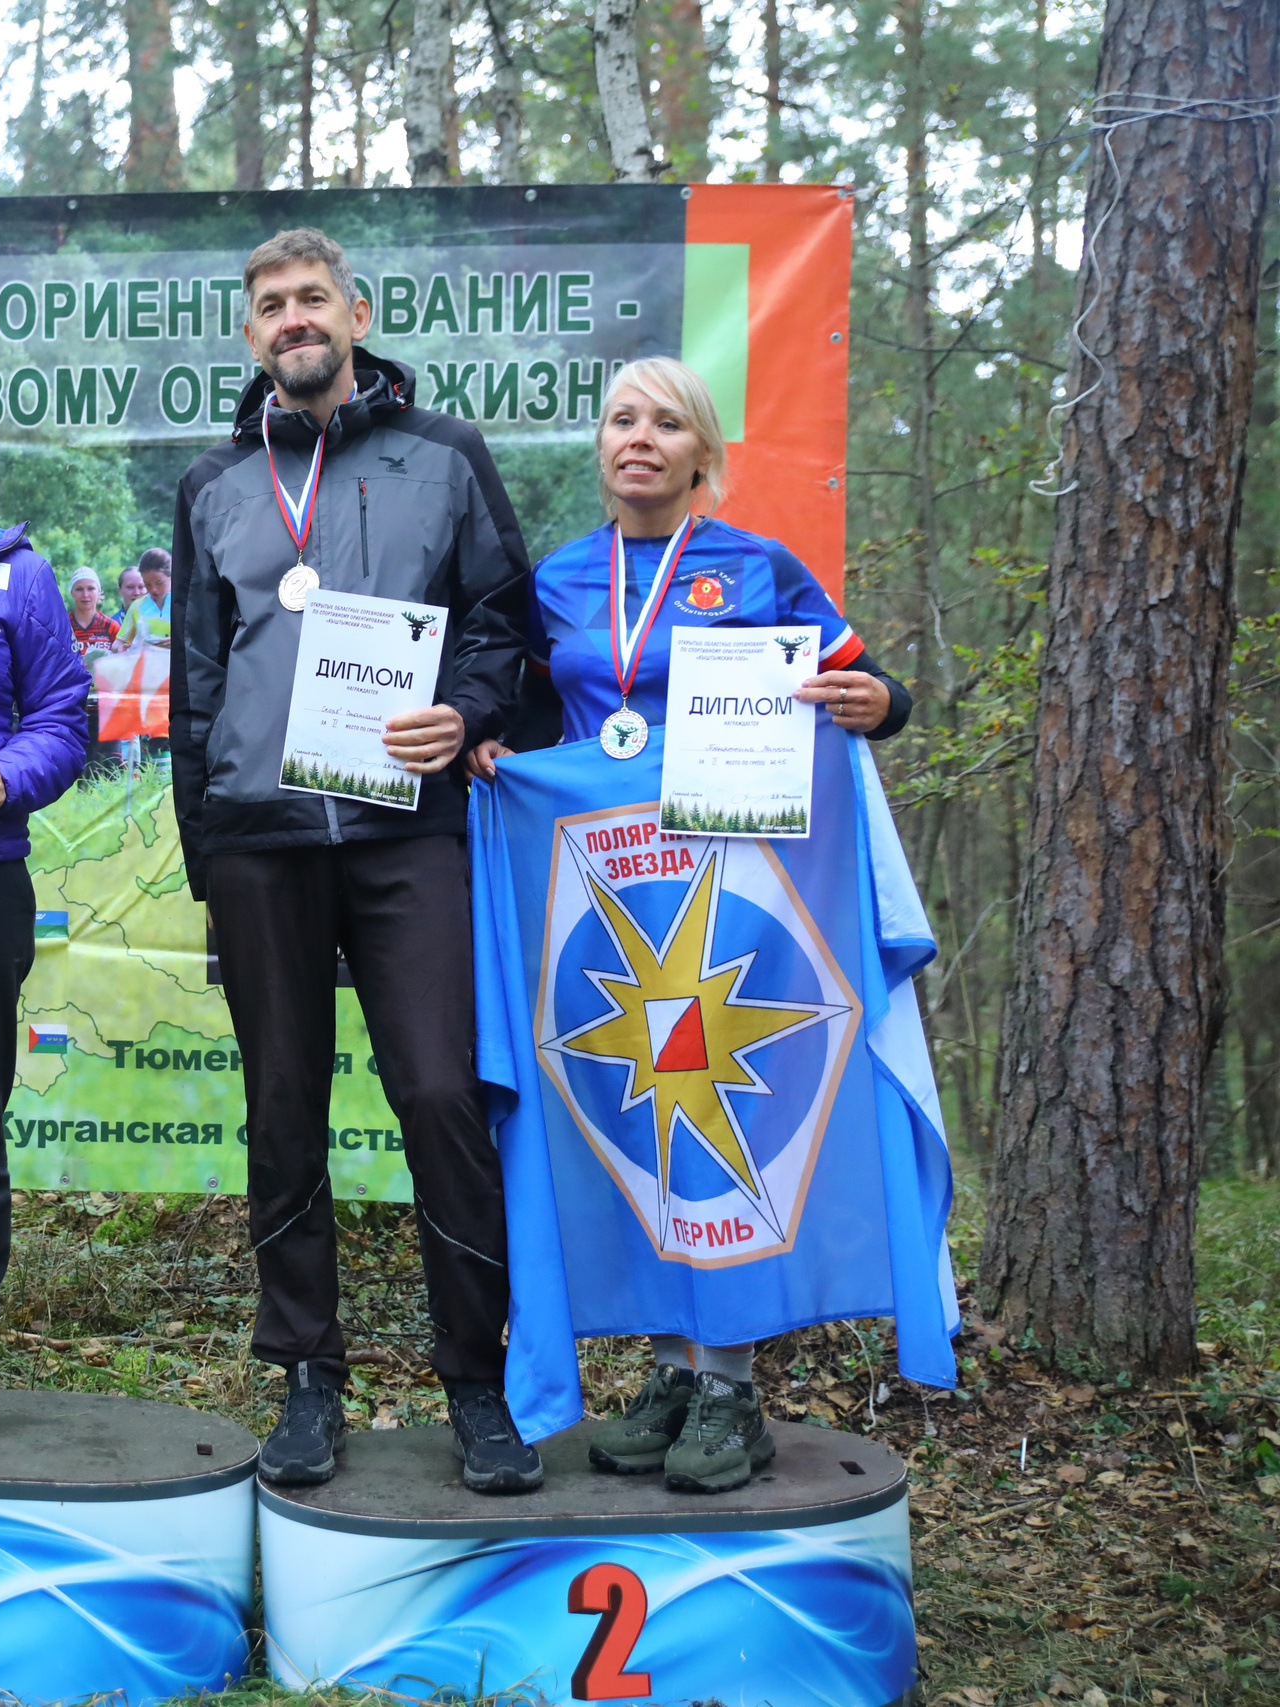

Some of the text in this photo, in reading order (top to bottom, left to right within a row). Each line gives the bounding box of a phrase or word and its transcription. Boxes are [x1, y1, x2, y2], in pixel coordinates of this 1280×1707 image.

[425, 358, 626, 423] ЖИЗН
[316, 658, 413, 689] ДИПЛОМ
[689, 696, 792, 715] ДИПЛОМ
[605, 848, 694, 880] ЗВЕЗДА
[672, 1216, 754, 1248] ПЕРМЬ
[567, 1562, 652, 1702] 2
